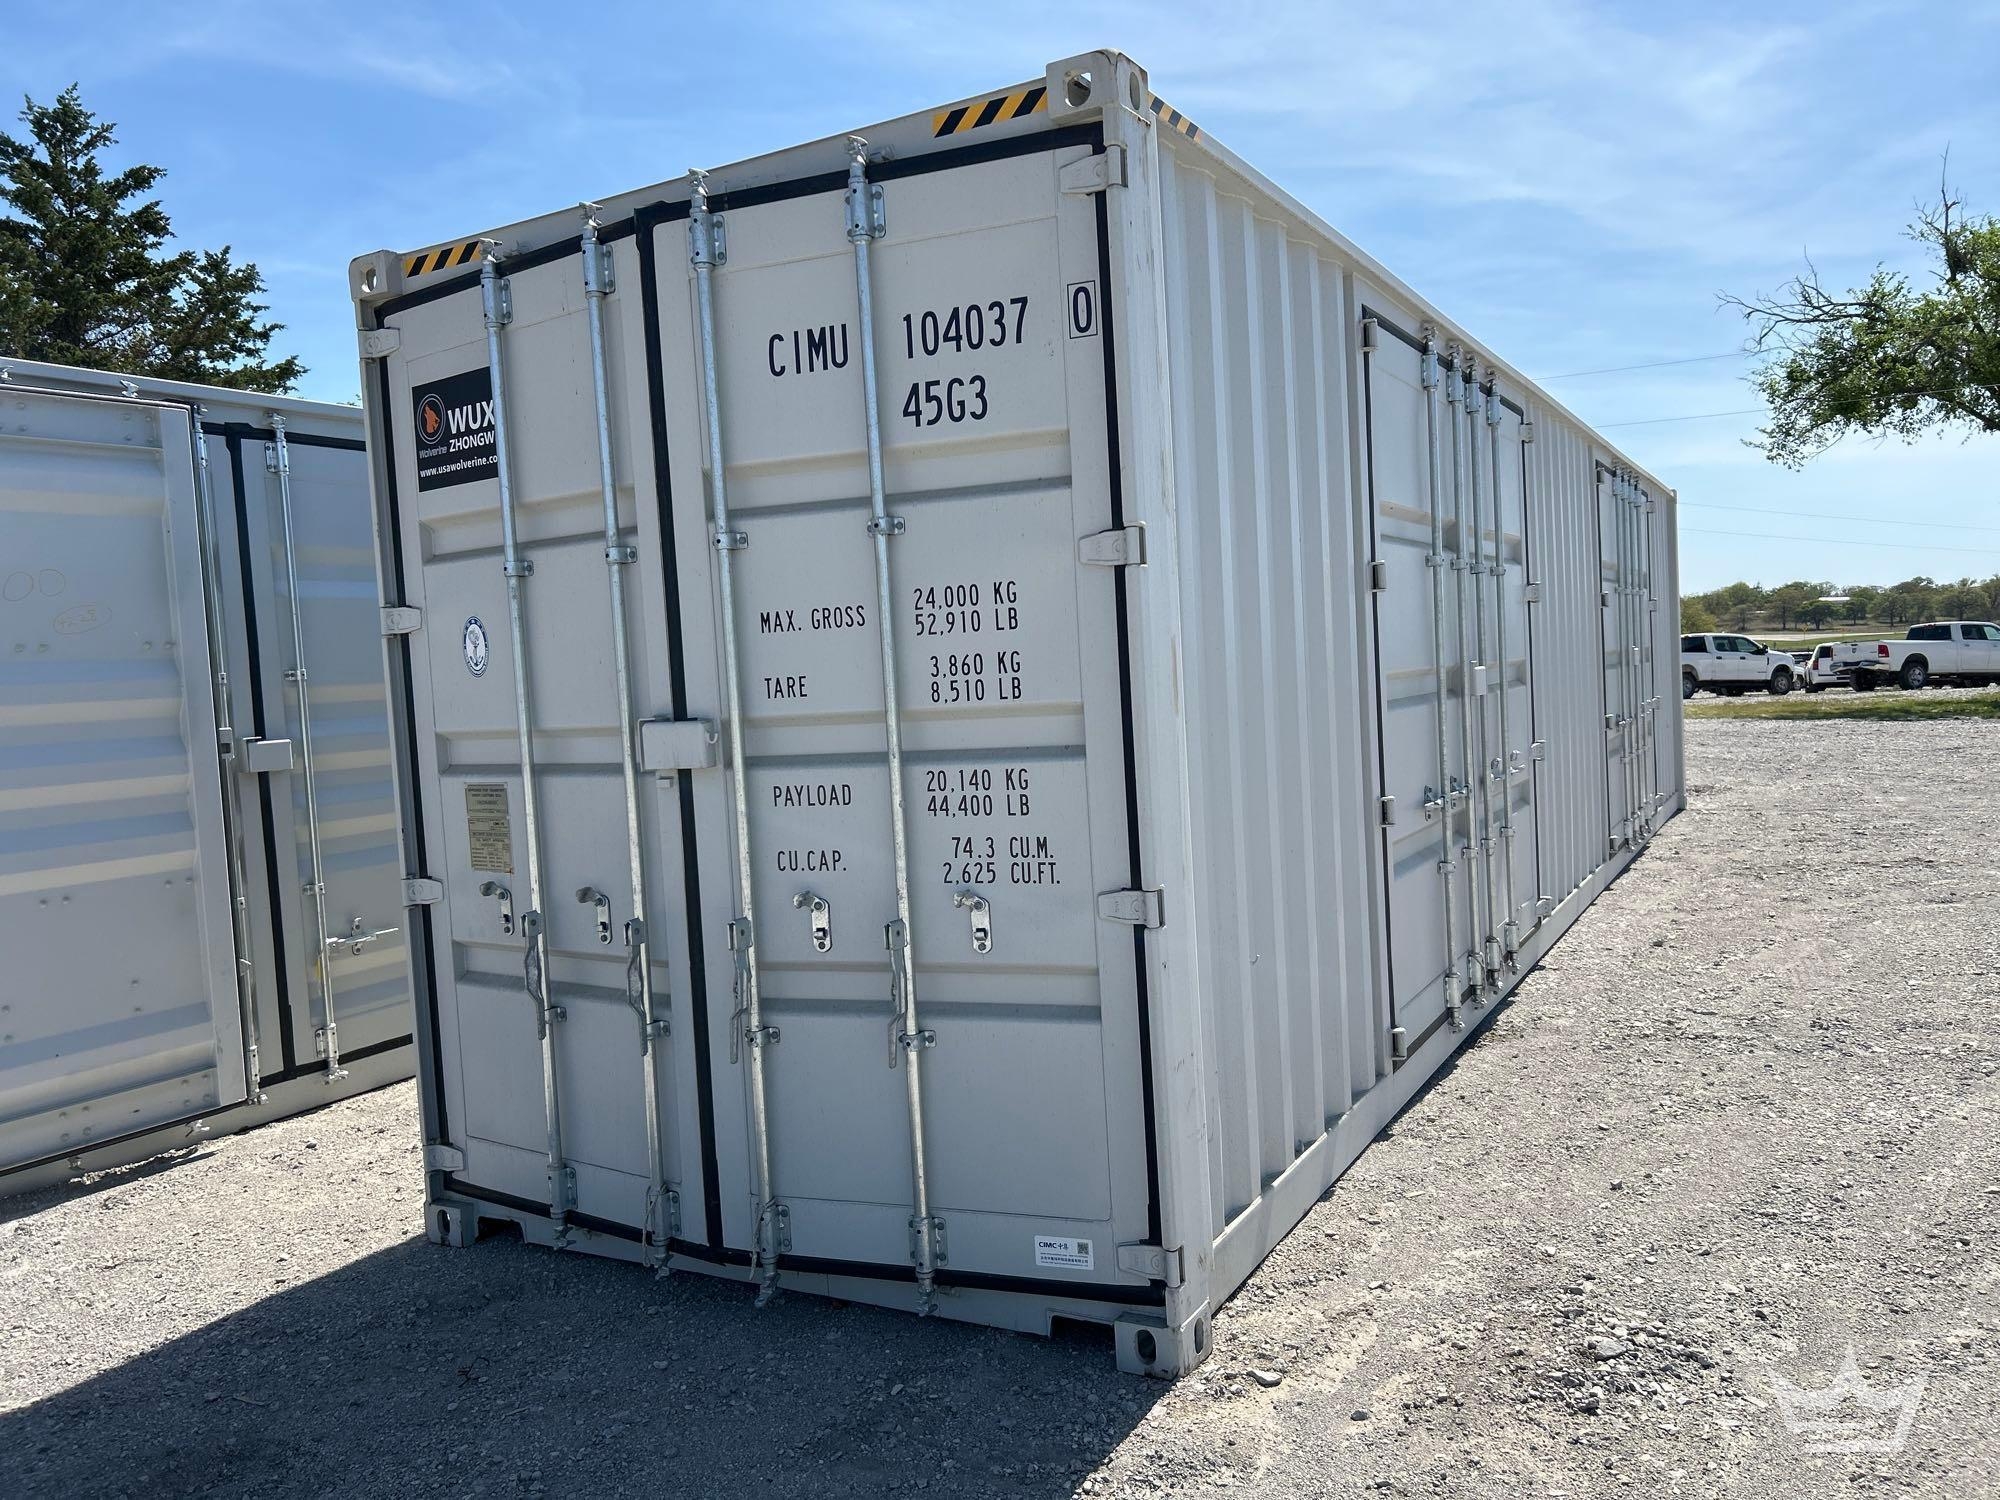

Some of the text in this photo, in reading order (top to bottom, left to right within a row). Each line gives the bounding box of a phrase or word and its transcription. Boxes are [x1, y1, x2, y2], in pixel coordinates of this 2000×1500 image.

[768, 285, 1093, 377] CIMU 104037 0
[902, 374, 988, 428] 45G3
[419, 445, 447, 459] Wolverine
[913, 580, 1017, 611] 24,000 KG
[760, 604, 866, 634] MAX. GROSS
[915, 606, 1019, 637] 52,910 LB
[929, 650, 1021, 679] 3,860 KG
[764, 675, 808, 700] TARE
[931, 676, 1022, 704] 8,510 LB
[926, 768, 1029, 793] 20,140 KG
[773, 783, 852, 808] PAYLOAD
[927, 793, 1030, 819] 44,400 LB
[951, 836, 1054, 859] 74.3 CU.M.
[777, 849, 847, 872] CU.CAP.
[942, 861, 1061, 886] 2,625 CU.FT.
[1038, 1241, 1057, 1249] CIMC
